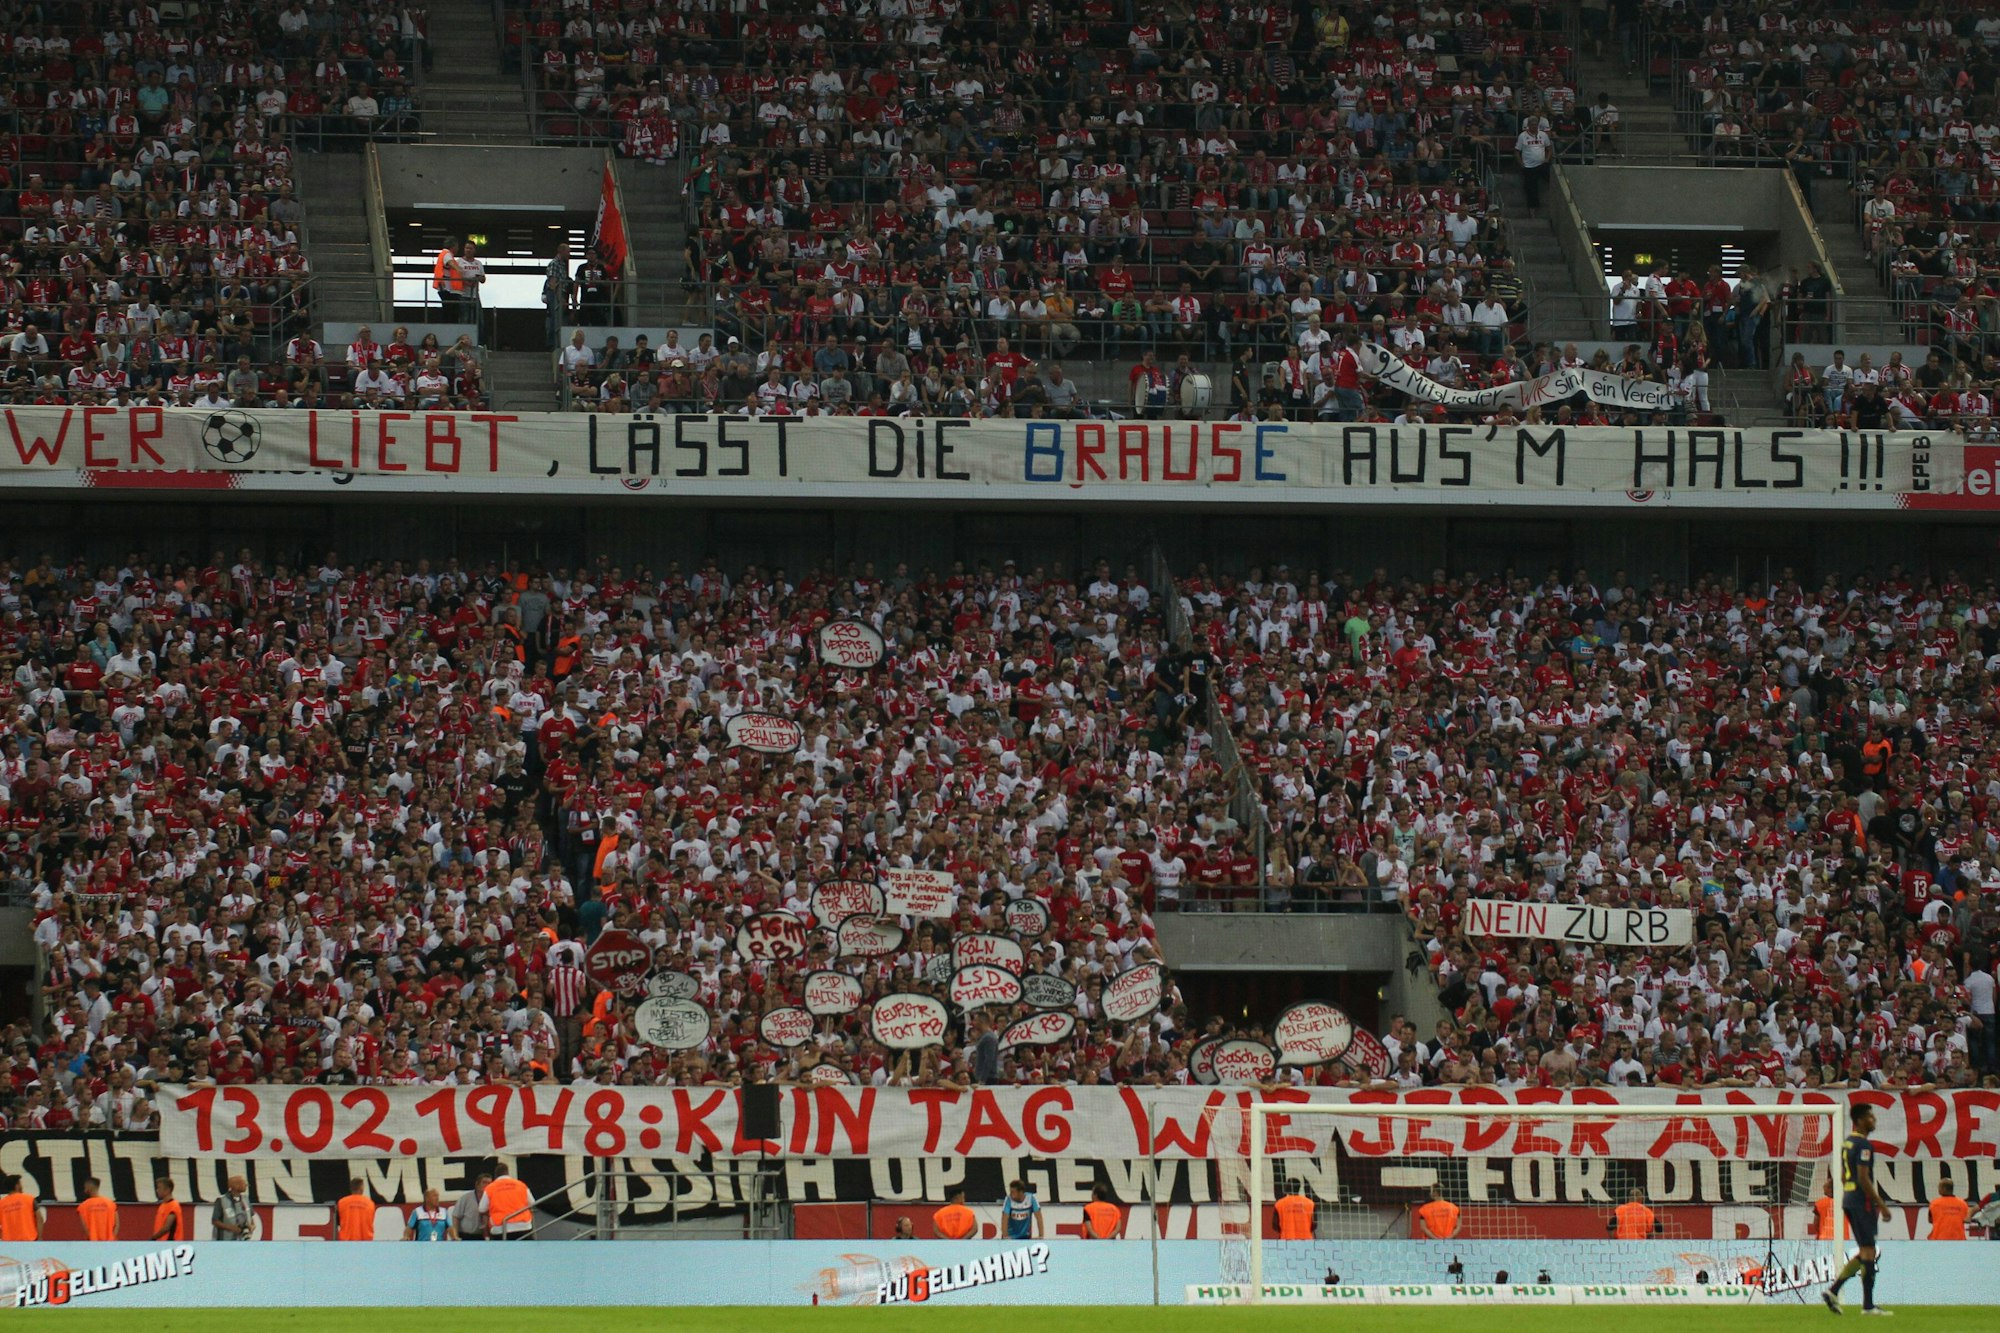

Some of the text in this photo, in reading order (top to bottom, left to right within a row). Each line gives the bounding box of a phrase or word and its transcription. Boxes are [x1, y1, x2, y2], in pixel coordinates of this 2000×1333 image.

[1520, 378, 1556, 406] WIR
[1592, 376, 1616, 398] ein
[1620, 378, 1671, 407] Verein
[5, 407, 165, 467] WER
[589, 414, 803, 477] LÄSST
[1025, 423, 1288, 482] BRAUSE
[1635, 429, 1804, 489] HALS
[823, 640, 870, 649] VERPISS
[838, 651, 878, 663] DICH!
[1913, 881, 1927, 897] 13
[1015, 902, 1033, 912] RB
[750, 917, 806, 946] FIGHT
[1470, 902, 1669, 942] NEIN ZU RB
[749, 941, 793, 960] RB
[957, 937, 996, 957] KÖLN
[591, 950, 646, 970] STOP
[1040, 1013, 1066, 1033] RB
[1286, 1008, 1305, 1022] RB
[879, 1018, 942, 1042] FICKT RB
[1261, 1053, 1272, 1066] G
[908, 1087, 1073, 1155] TAG
[1119, 1087, 1317, 1157] WIE
[1348, 1087, 1619, 1157] JEDER
[16, 1244, 196, 1307] FLÜGELLAHM?
[877, 1242, 1049, 1304] FLÜGELLAHM?
[1198, 1287, 1241, 1298] HDI
[1261, 1285, 1303, 1297] HDI
[1321, 1286, 1364, 1298] HDI
[1389, 1286, 1432, 1296] HDI
[1450, 1286, 1494, 1296] HDI
[1513, 1286, 1555, 1296] HDI
[1583, 1286, 1627, 1296] HDI
[1706, 1286, 1749, 1297] HDI
